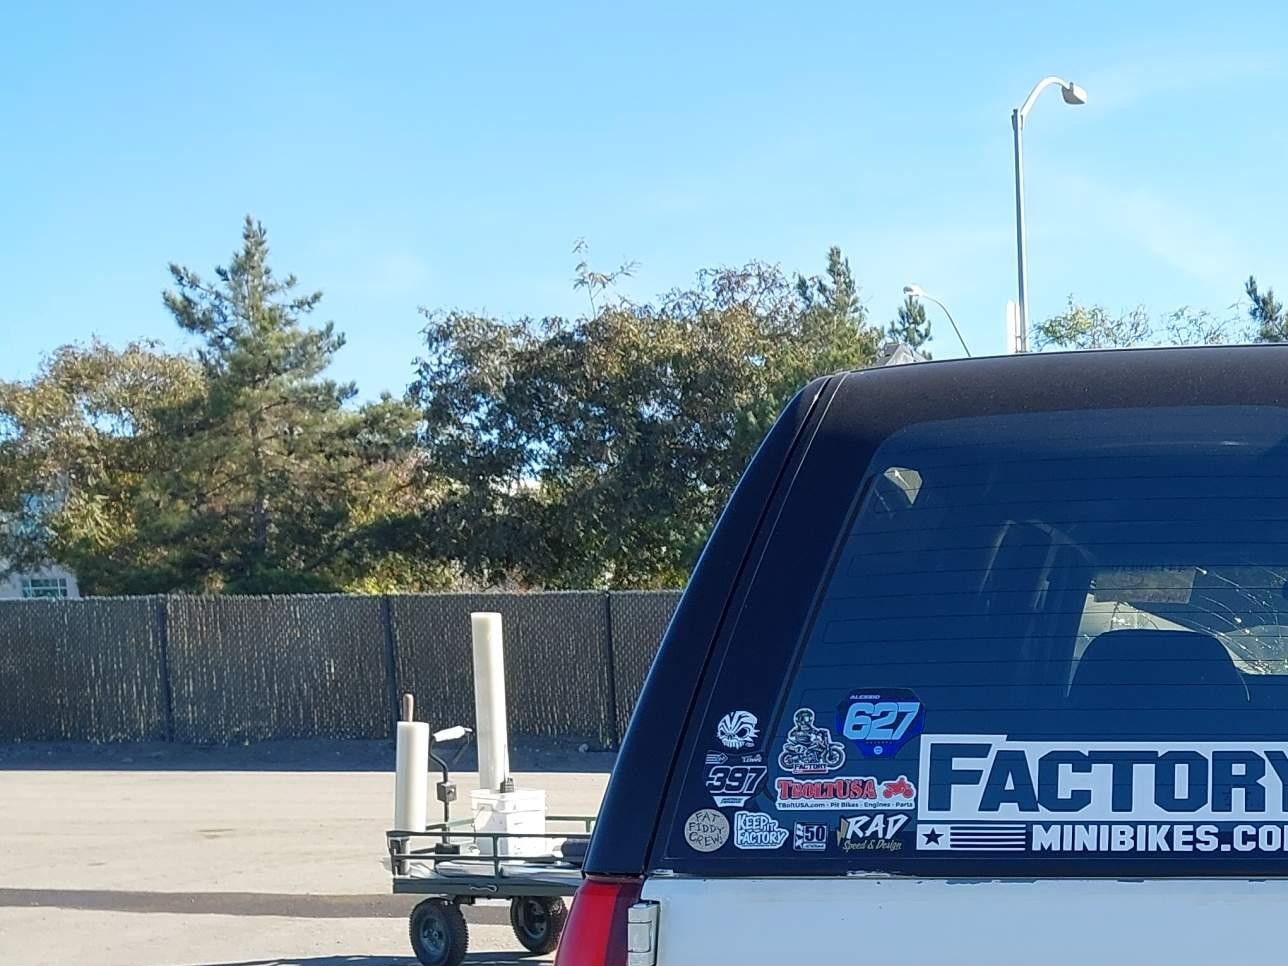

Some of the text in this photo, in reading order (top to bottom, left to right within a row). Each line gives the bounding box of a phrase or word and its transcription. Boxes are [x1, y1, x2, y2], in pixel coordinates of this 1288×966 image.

[843, 702, 920, 740] 627
[706, 766, 767, 793] 397
[695, 812, 721, 824] FAT
[737, 813, 776, 832] KEEP IT
[804, 825, 826, 841] 50
[846, 813, 909, 840] RAD
[688, 833, 721, 848] CREW
[737, 831, 787, 845] FACTORY
[843, 840, 902, 852] Speed & Design
